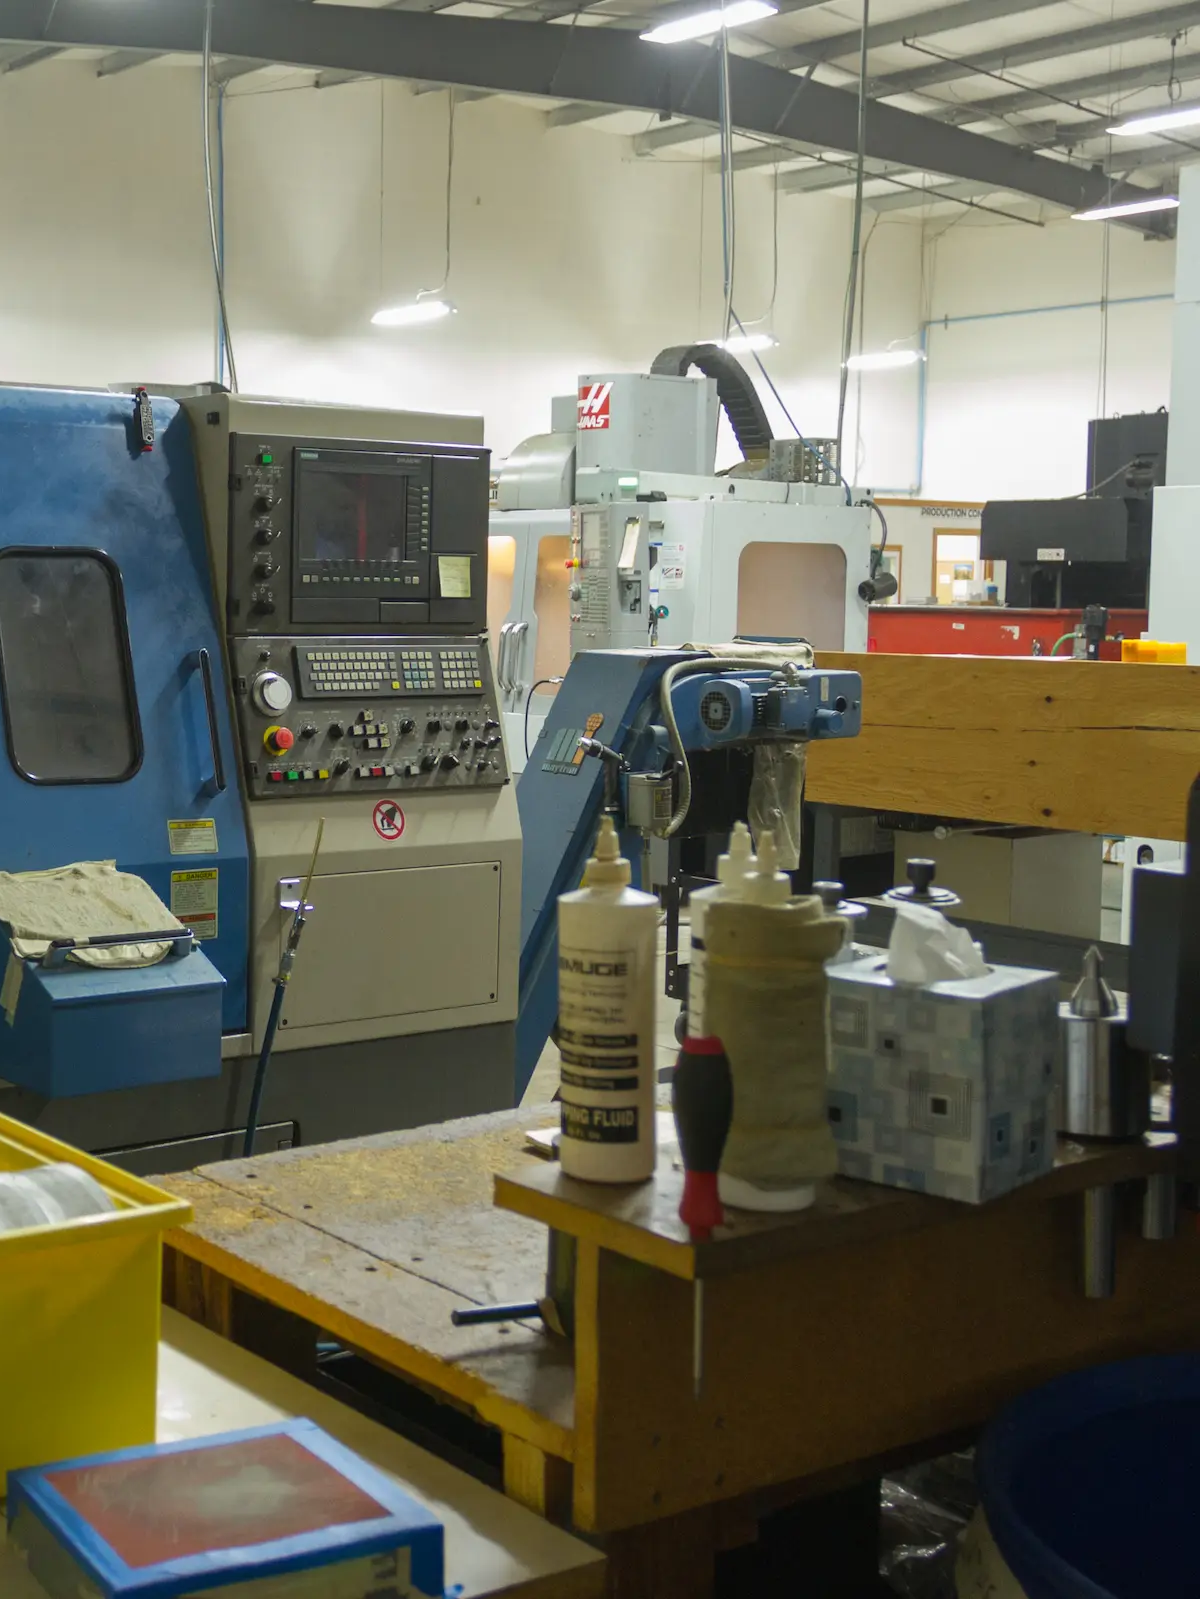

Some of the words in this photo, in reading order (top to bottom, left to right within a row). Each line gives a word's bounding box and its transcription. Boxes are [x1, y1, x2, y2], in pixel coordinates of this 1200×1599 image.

[577, 415, 610, 428] HAAS
[921, 506, 966, 518] PRODUCTION
[593, 1109, 634, 1127] FLUID
